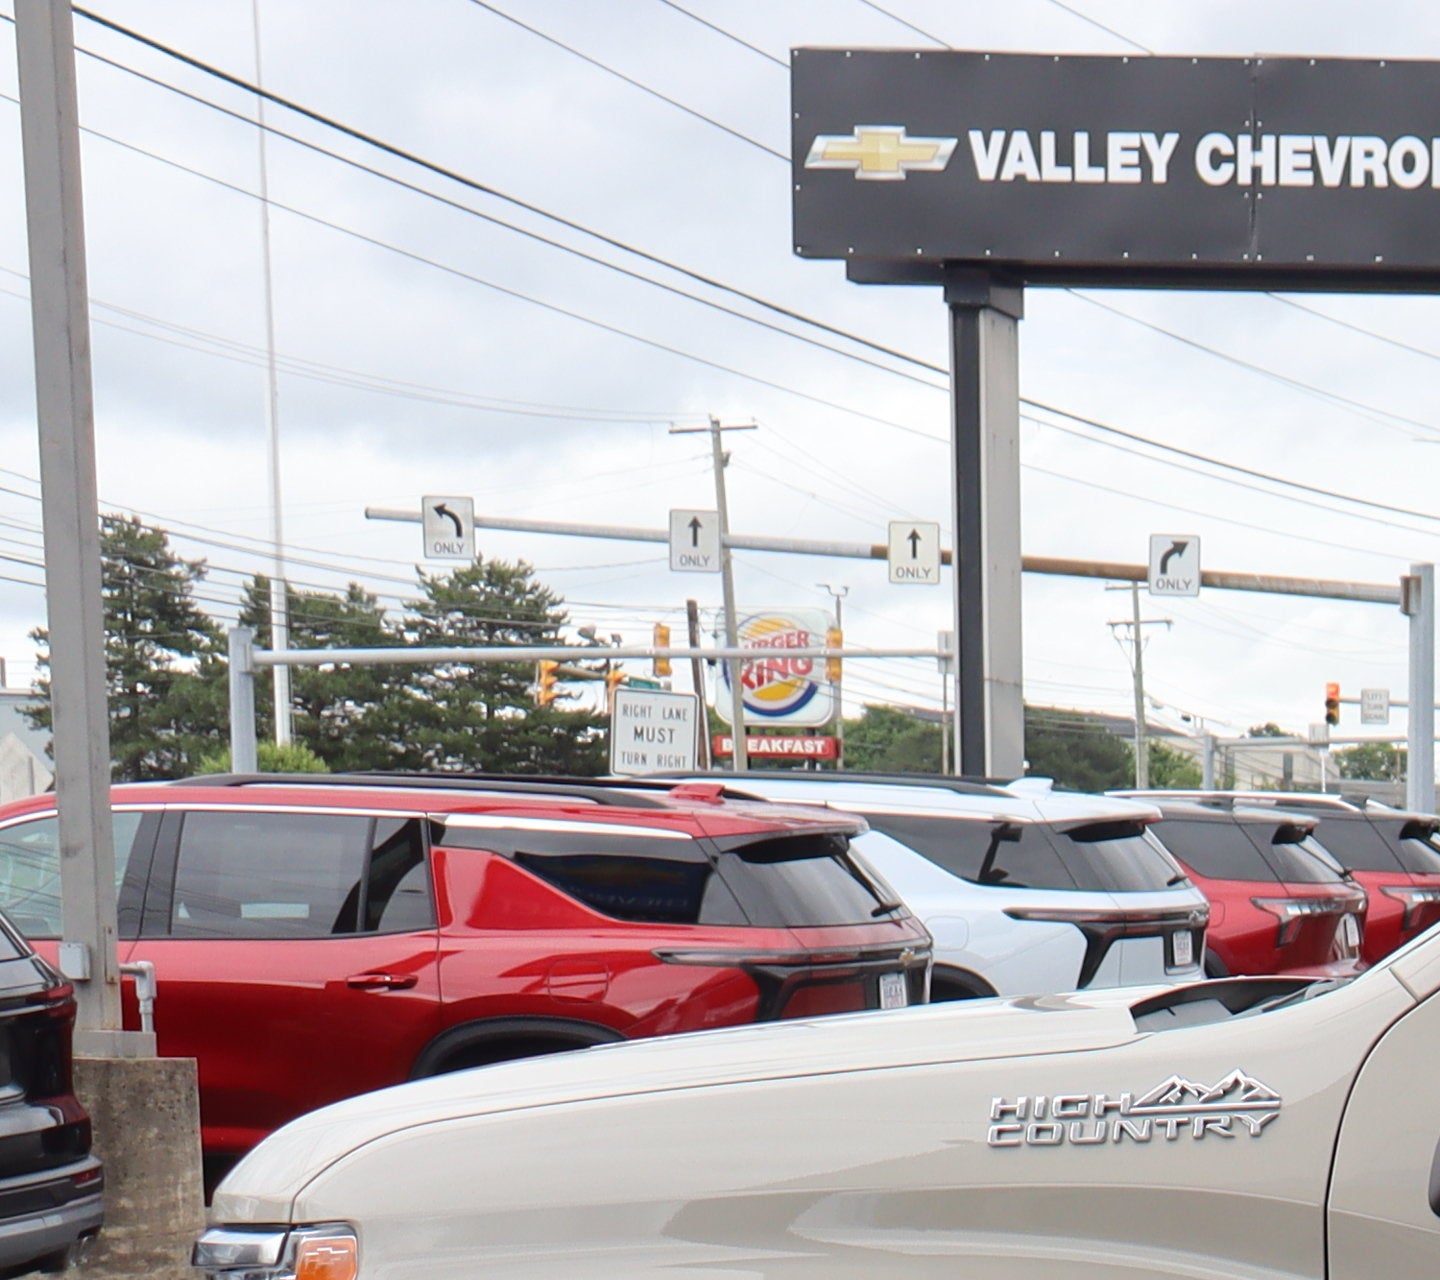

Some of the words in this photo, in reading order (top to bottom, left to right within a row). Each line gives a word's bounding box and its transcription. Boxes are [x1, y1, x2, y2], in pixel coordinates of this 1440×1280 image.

[967, 129, 1179, 185] VALLEY
[433, 541, 465, 555] ONLY
[679, 554, 711, 567] ONLY
[895, 566, 932, 580] ONLY
[1155, 577, 1193, 591] ONLY
[621, 704, 653, 719] RIGHT
[662, 706, 688, 721] LANE
[633, 725, 676, 744] MUST
[722, 738, 825, 754] BEAKFAST
[621, 751, 648, 767] TURN
[656, 753, 688, 768] RIGHT
[990, 1092, 1133, 1121] HIGH
[987, 1112, 1280, 1148] COUNTRY
